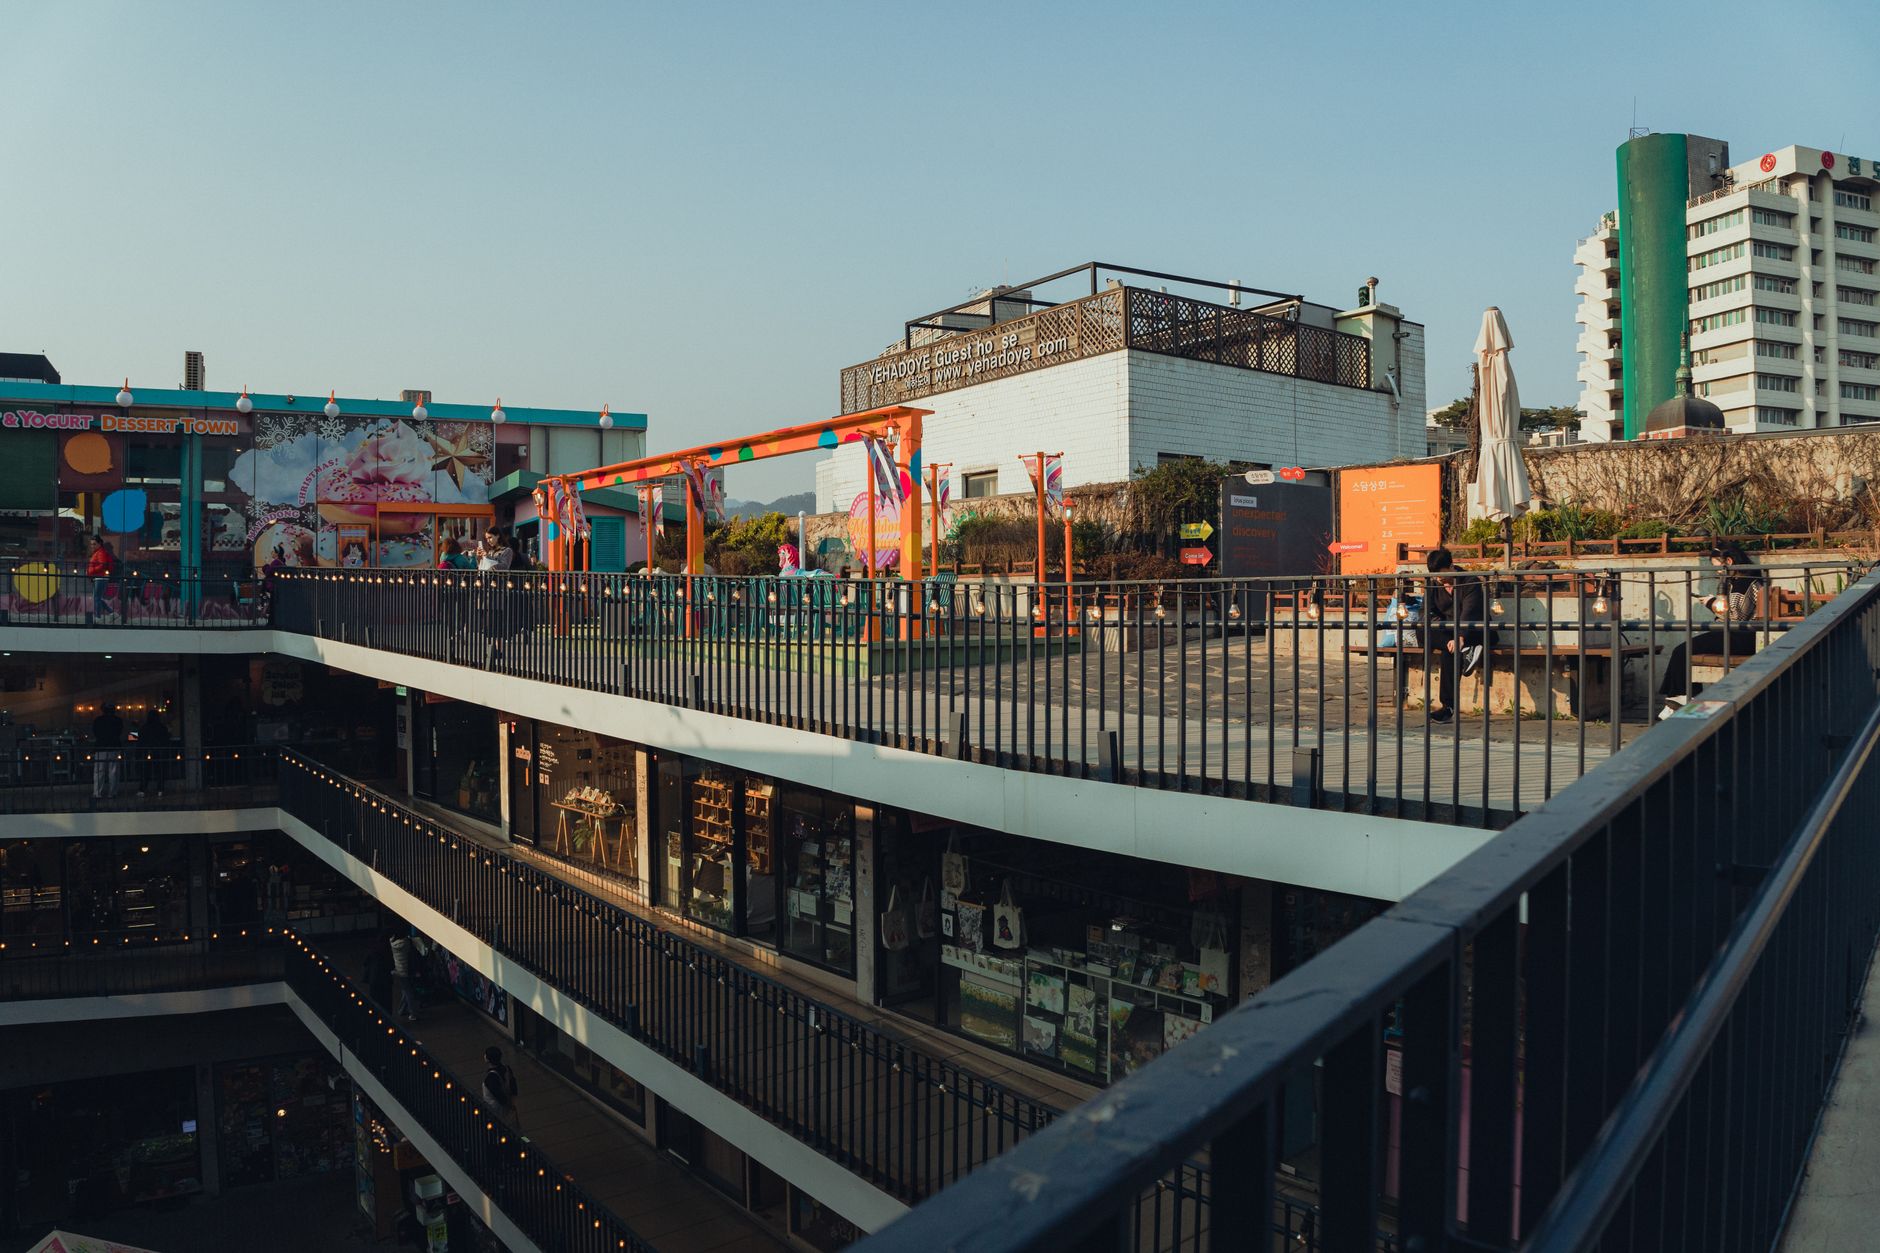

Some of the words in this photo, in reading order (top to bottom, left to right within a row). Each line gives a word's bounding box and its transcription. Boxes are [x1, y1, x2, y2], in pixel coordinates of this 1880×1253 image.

[868, 353, 931, 385] YEHADOYE
[935, 345, 972, 367] Guest
[17, 410, 93, 430] YOGURT
[101, 414, 179, 433] DESSERT
[180, 417, 239, 436] TOWN
[298, 457, 339, 508] CHRISTMAS!
